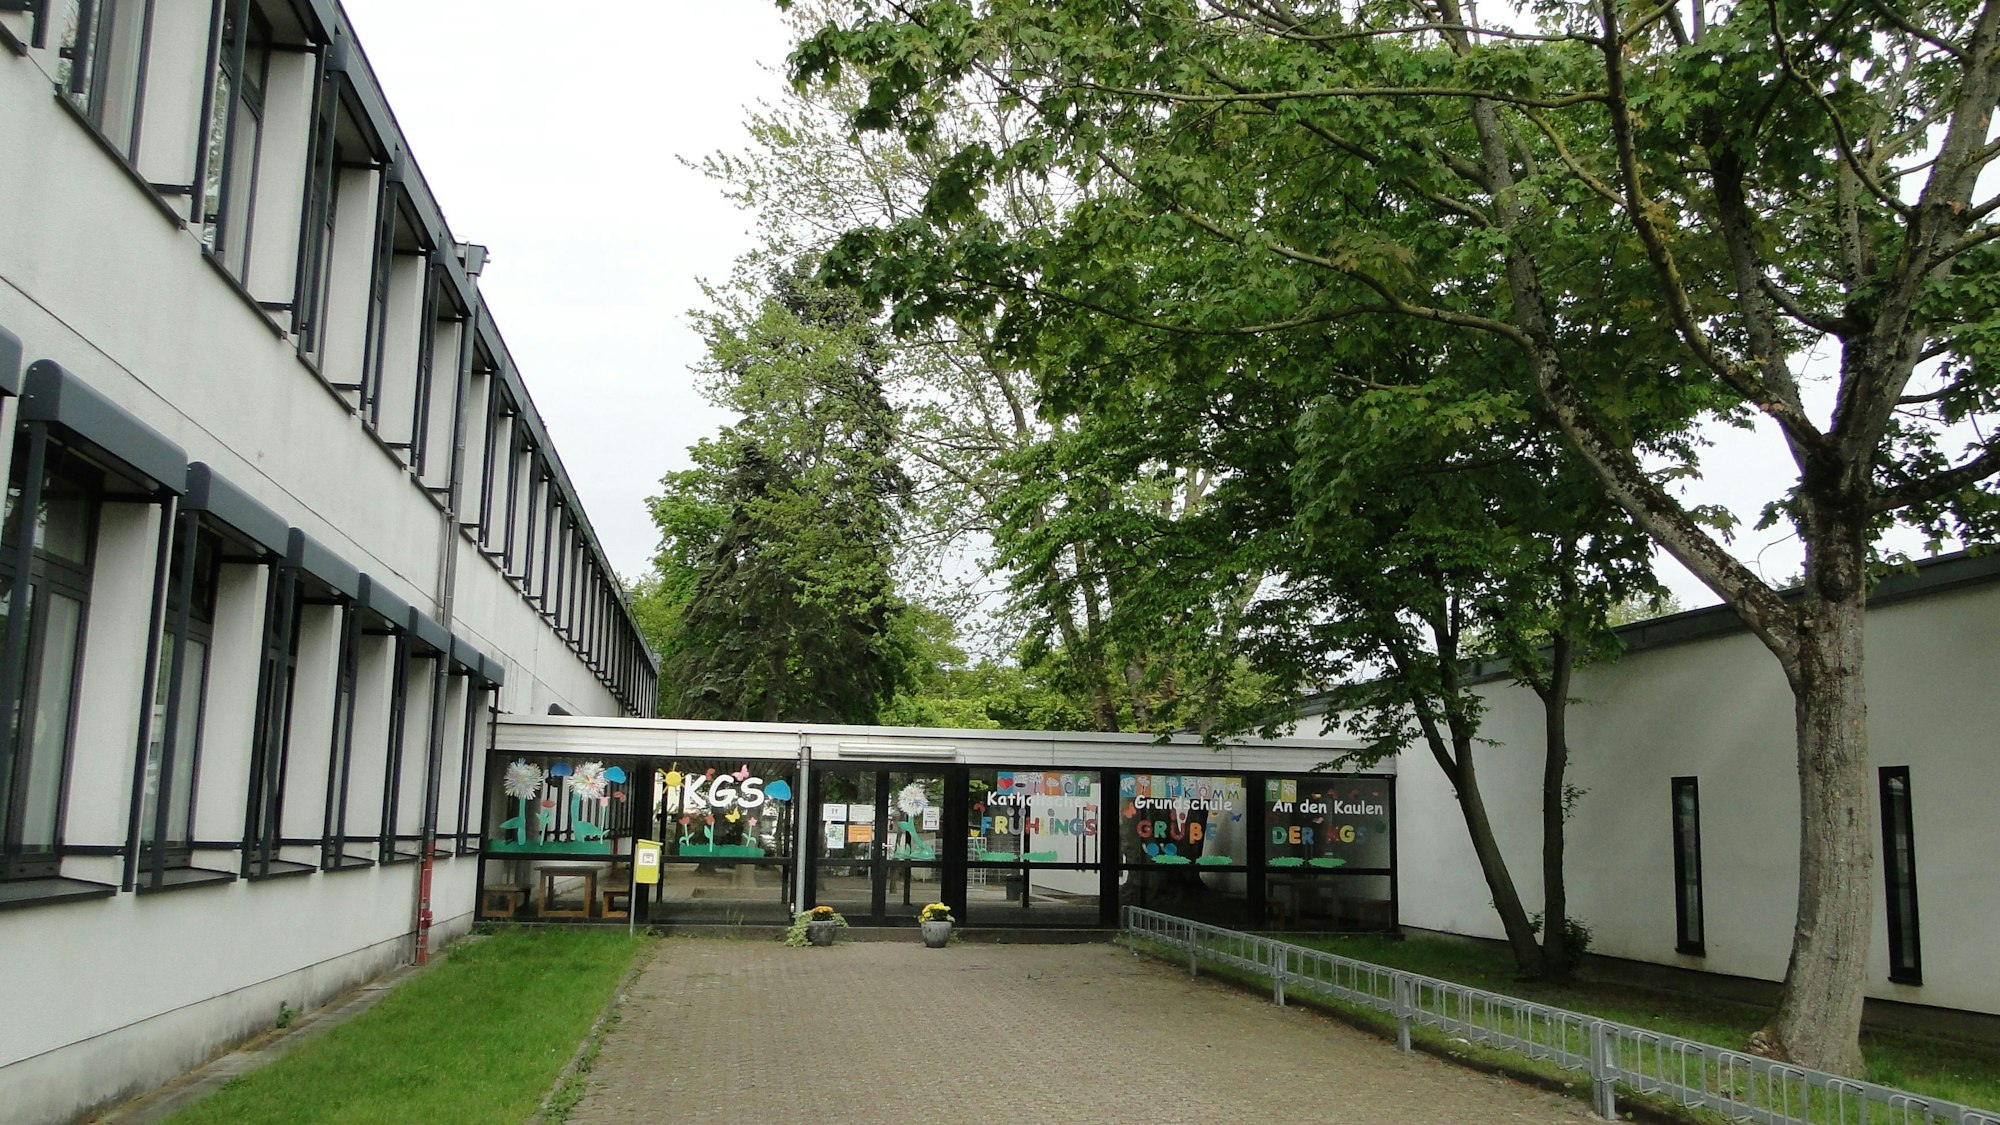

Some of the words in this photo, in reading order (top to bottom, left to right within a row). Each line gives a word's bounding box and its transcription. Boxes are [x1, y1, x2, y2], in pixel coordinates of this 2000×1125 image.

[684, 773, 765, 809] KGS
[987, 791, 1083, 807] Katholische
[1134, 795, 1233, 811] Grundschule
[1272, 798, 1294, 814] An
[1299, 798, 1328, 814] den
[1334, 800, 1384, 815] Kaulen
[1272, 825, 1315, 845] DER
